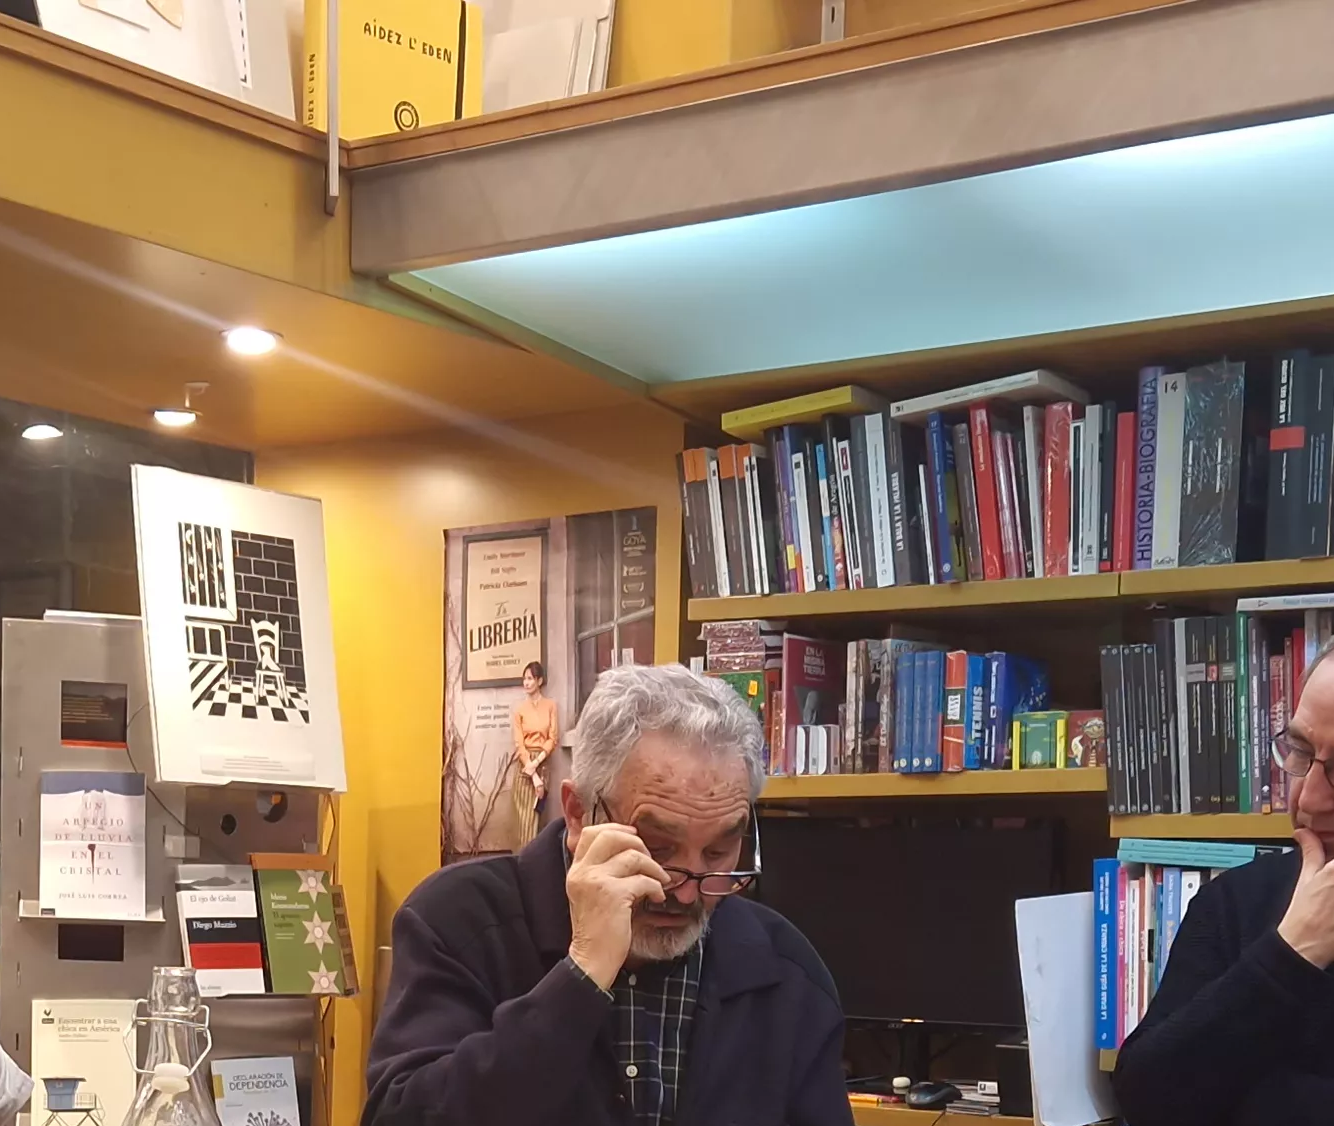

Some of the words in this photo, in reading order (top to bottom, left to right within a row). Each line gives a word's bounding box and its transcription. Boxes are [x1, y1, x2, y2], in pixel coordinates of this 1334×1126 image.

[896, 541, 904, 551] LA
[469, 608, 537, 653] LIBRERÍA
[970, 686, 983, 739] TENNIS
[84, 802, 103, 810] UN
[71, 851, 88, 860] EN
[97, 851, 114, 860] EL
[229, 1080, 288, 1091] DEPENDENCIA
